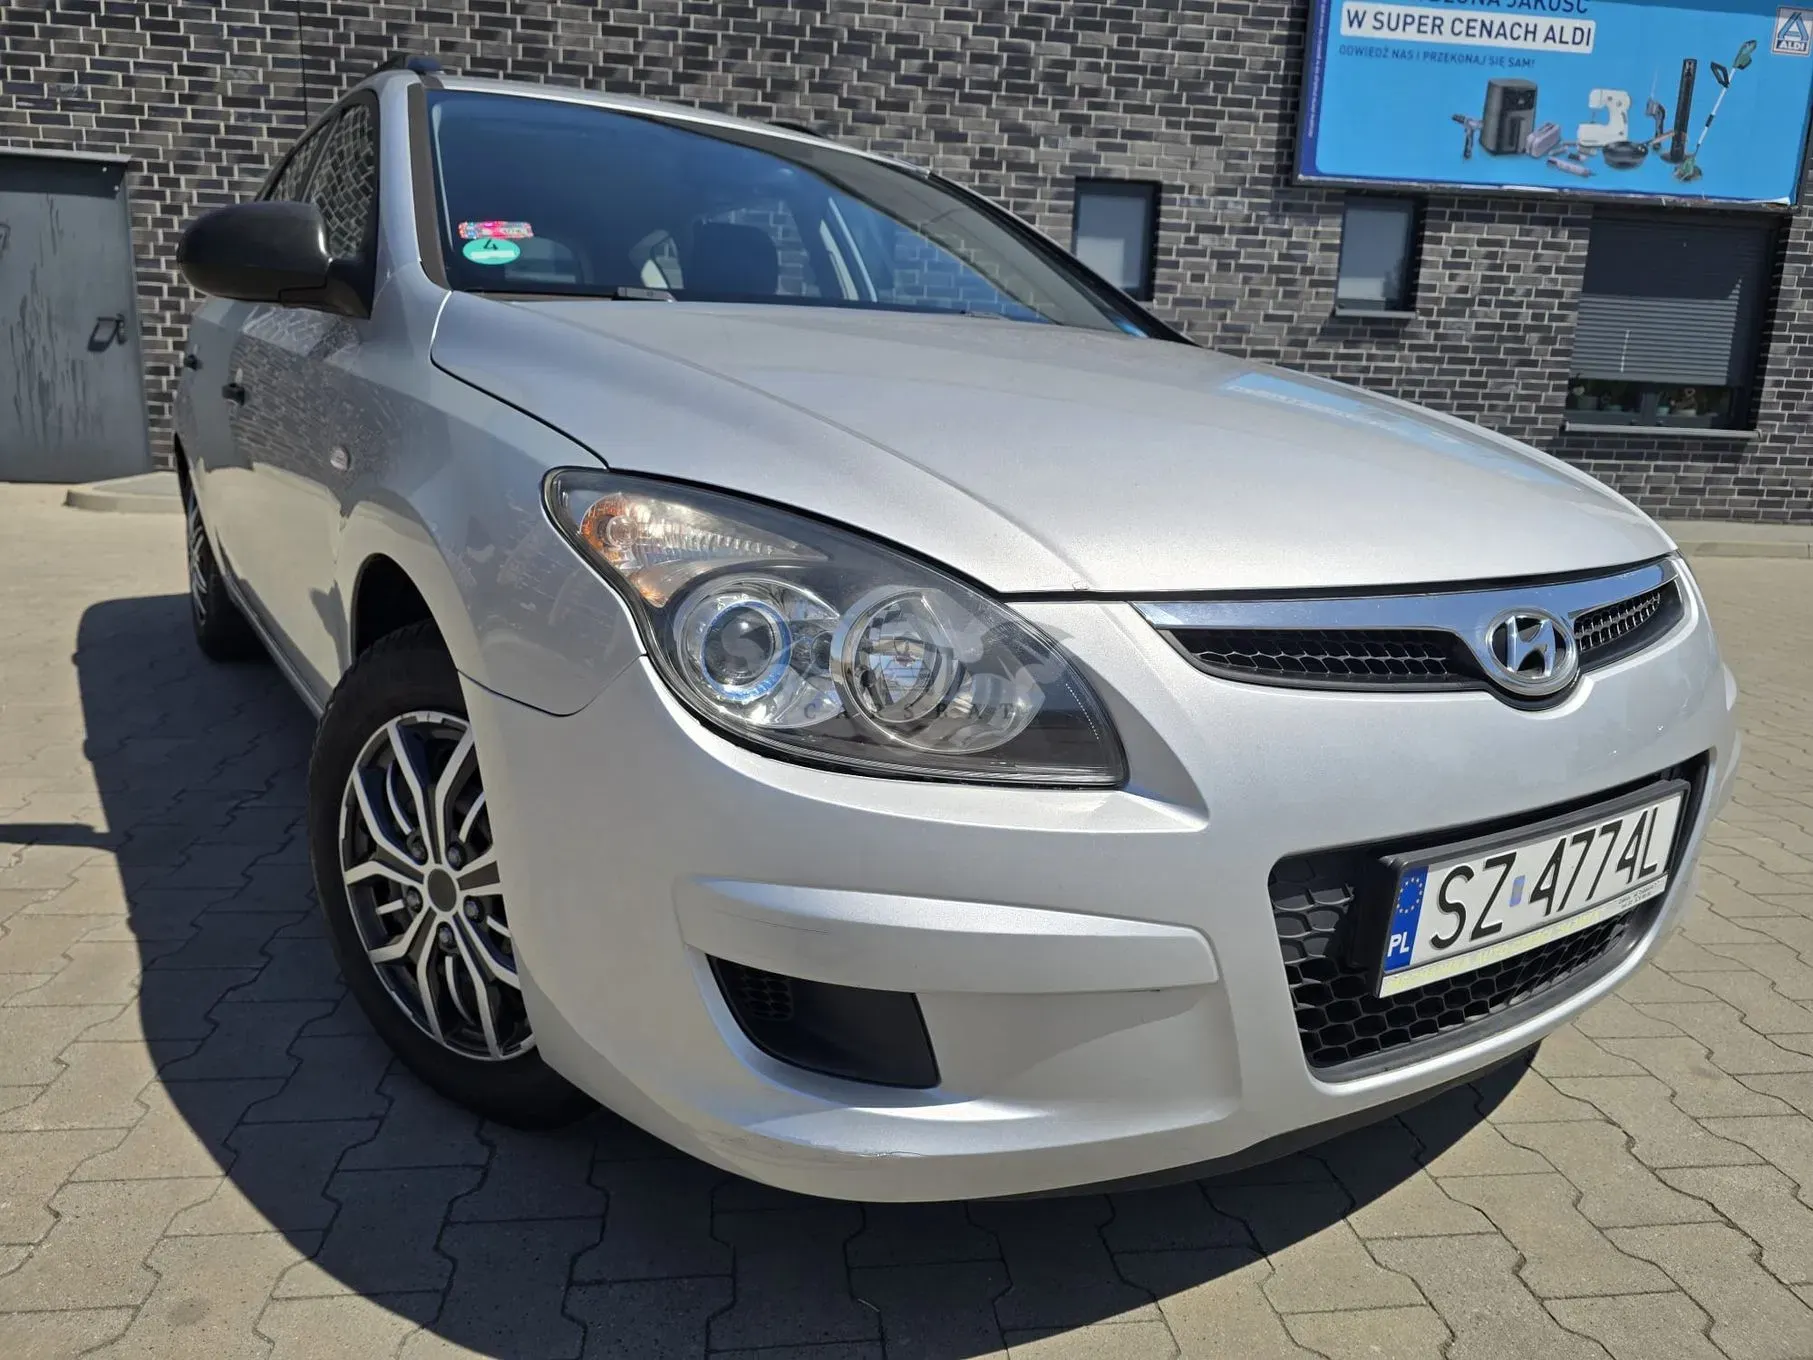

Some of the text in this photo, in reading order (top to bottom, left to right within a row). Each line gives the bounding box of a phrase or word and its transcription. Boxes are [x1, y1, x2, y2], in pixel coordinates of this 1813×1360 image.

[1347, 9, 1592, 47] W SUPER CENACH ALDI
[1391, 48, 1414, 60] NAS
[1423, 50, 1487, 66] PRZEKONAJ
[1779, 40, 1805, 51] ALDI
[1430, 807, 1659, 950] SZ 4774L
[1387, 933, 1410, 958] PL
